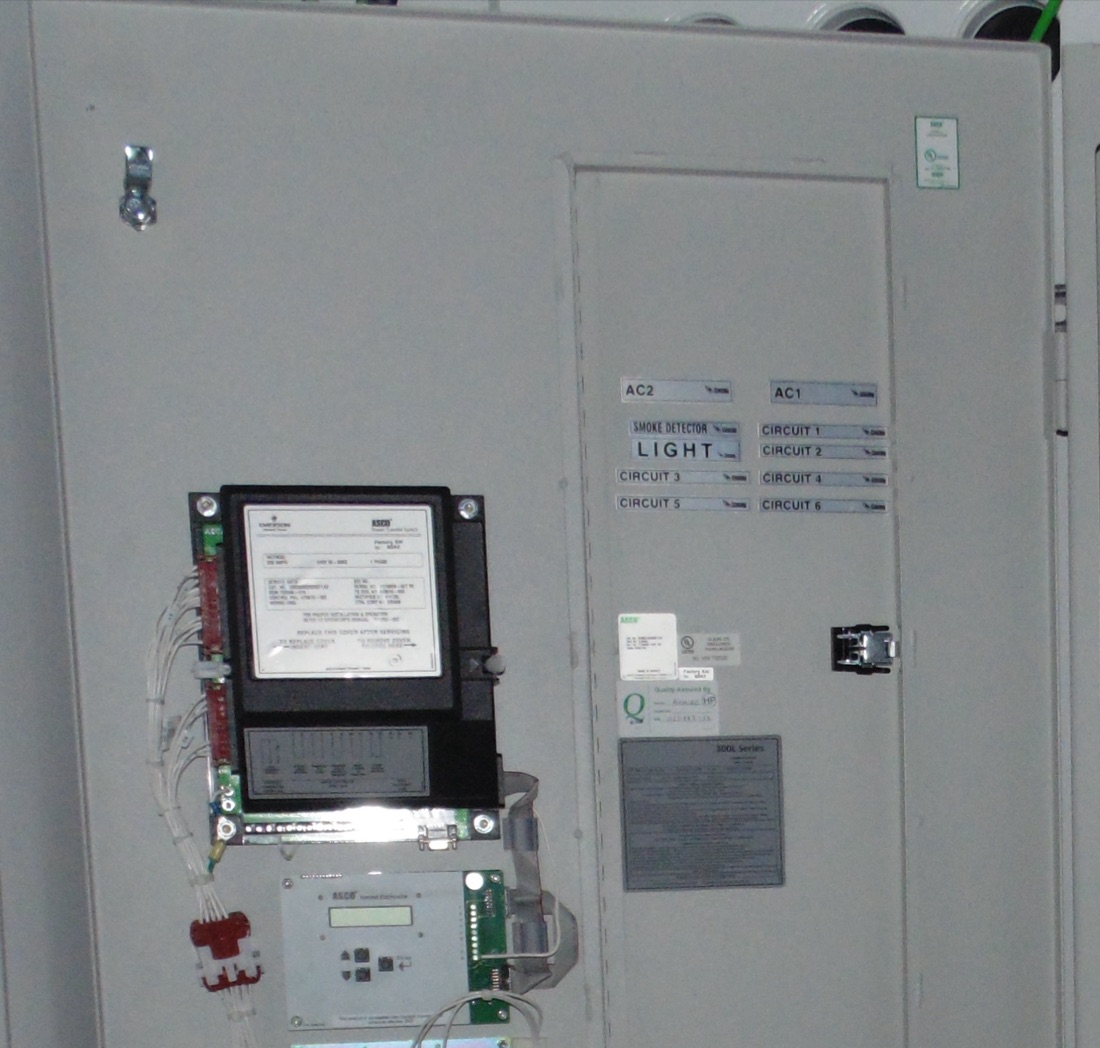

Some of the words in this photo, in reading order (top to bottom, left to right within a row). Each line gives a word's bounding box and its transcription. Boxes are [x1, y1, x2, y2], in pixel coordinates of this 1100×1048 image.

[626, 384, 654, 396] AC2
[775, 387, 800, 399] AC1
[633, 421, 661, 433] SMOKE
[665, 422, 707, 434] DETECTOR
[762, 425, 810, 436] CIRCUIT
[815, 427, 820, 436] 1
[638, 441, 712, 458] LIGHT
[763, 445, 811, 457] CIRCUIT
[815, 447, 822, 457] 2
[619, 471, 670, 481] CIRCUIT
[674, 472, 680, 482] 3
[762, 473, 811, 484] CIRCUIT
[815, 474, 822, 484] 4
[619, 498, 670, 509] CIRCUIT
[674, 499, 680, 509] 5
[762, 500, 810, 511] CIRCUIT
[815, 501, 821, 511] 6
[739, 743, 765, 752] Series
